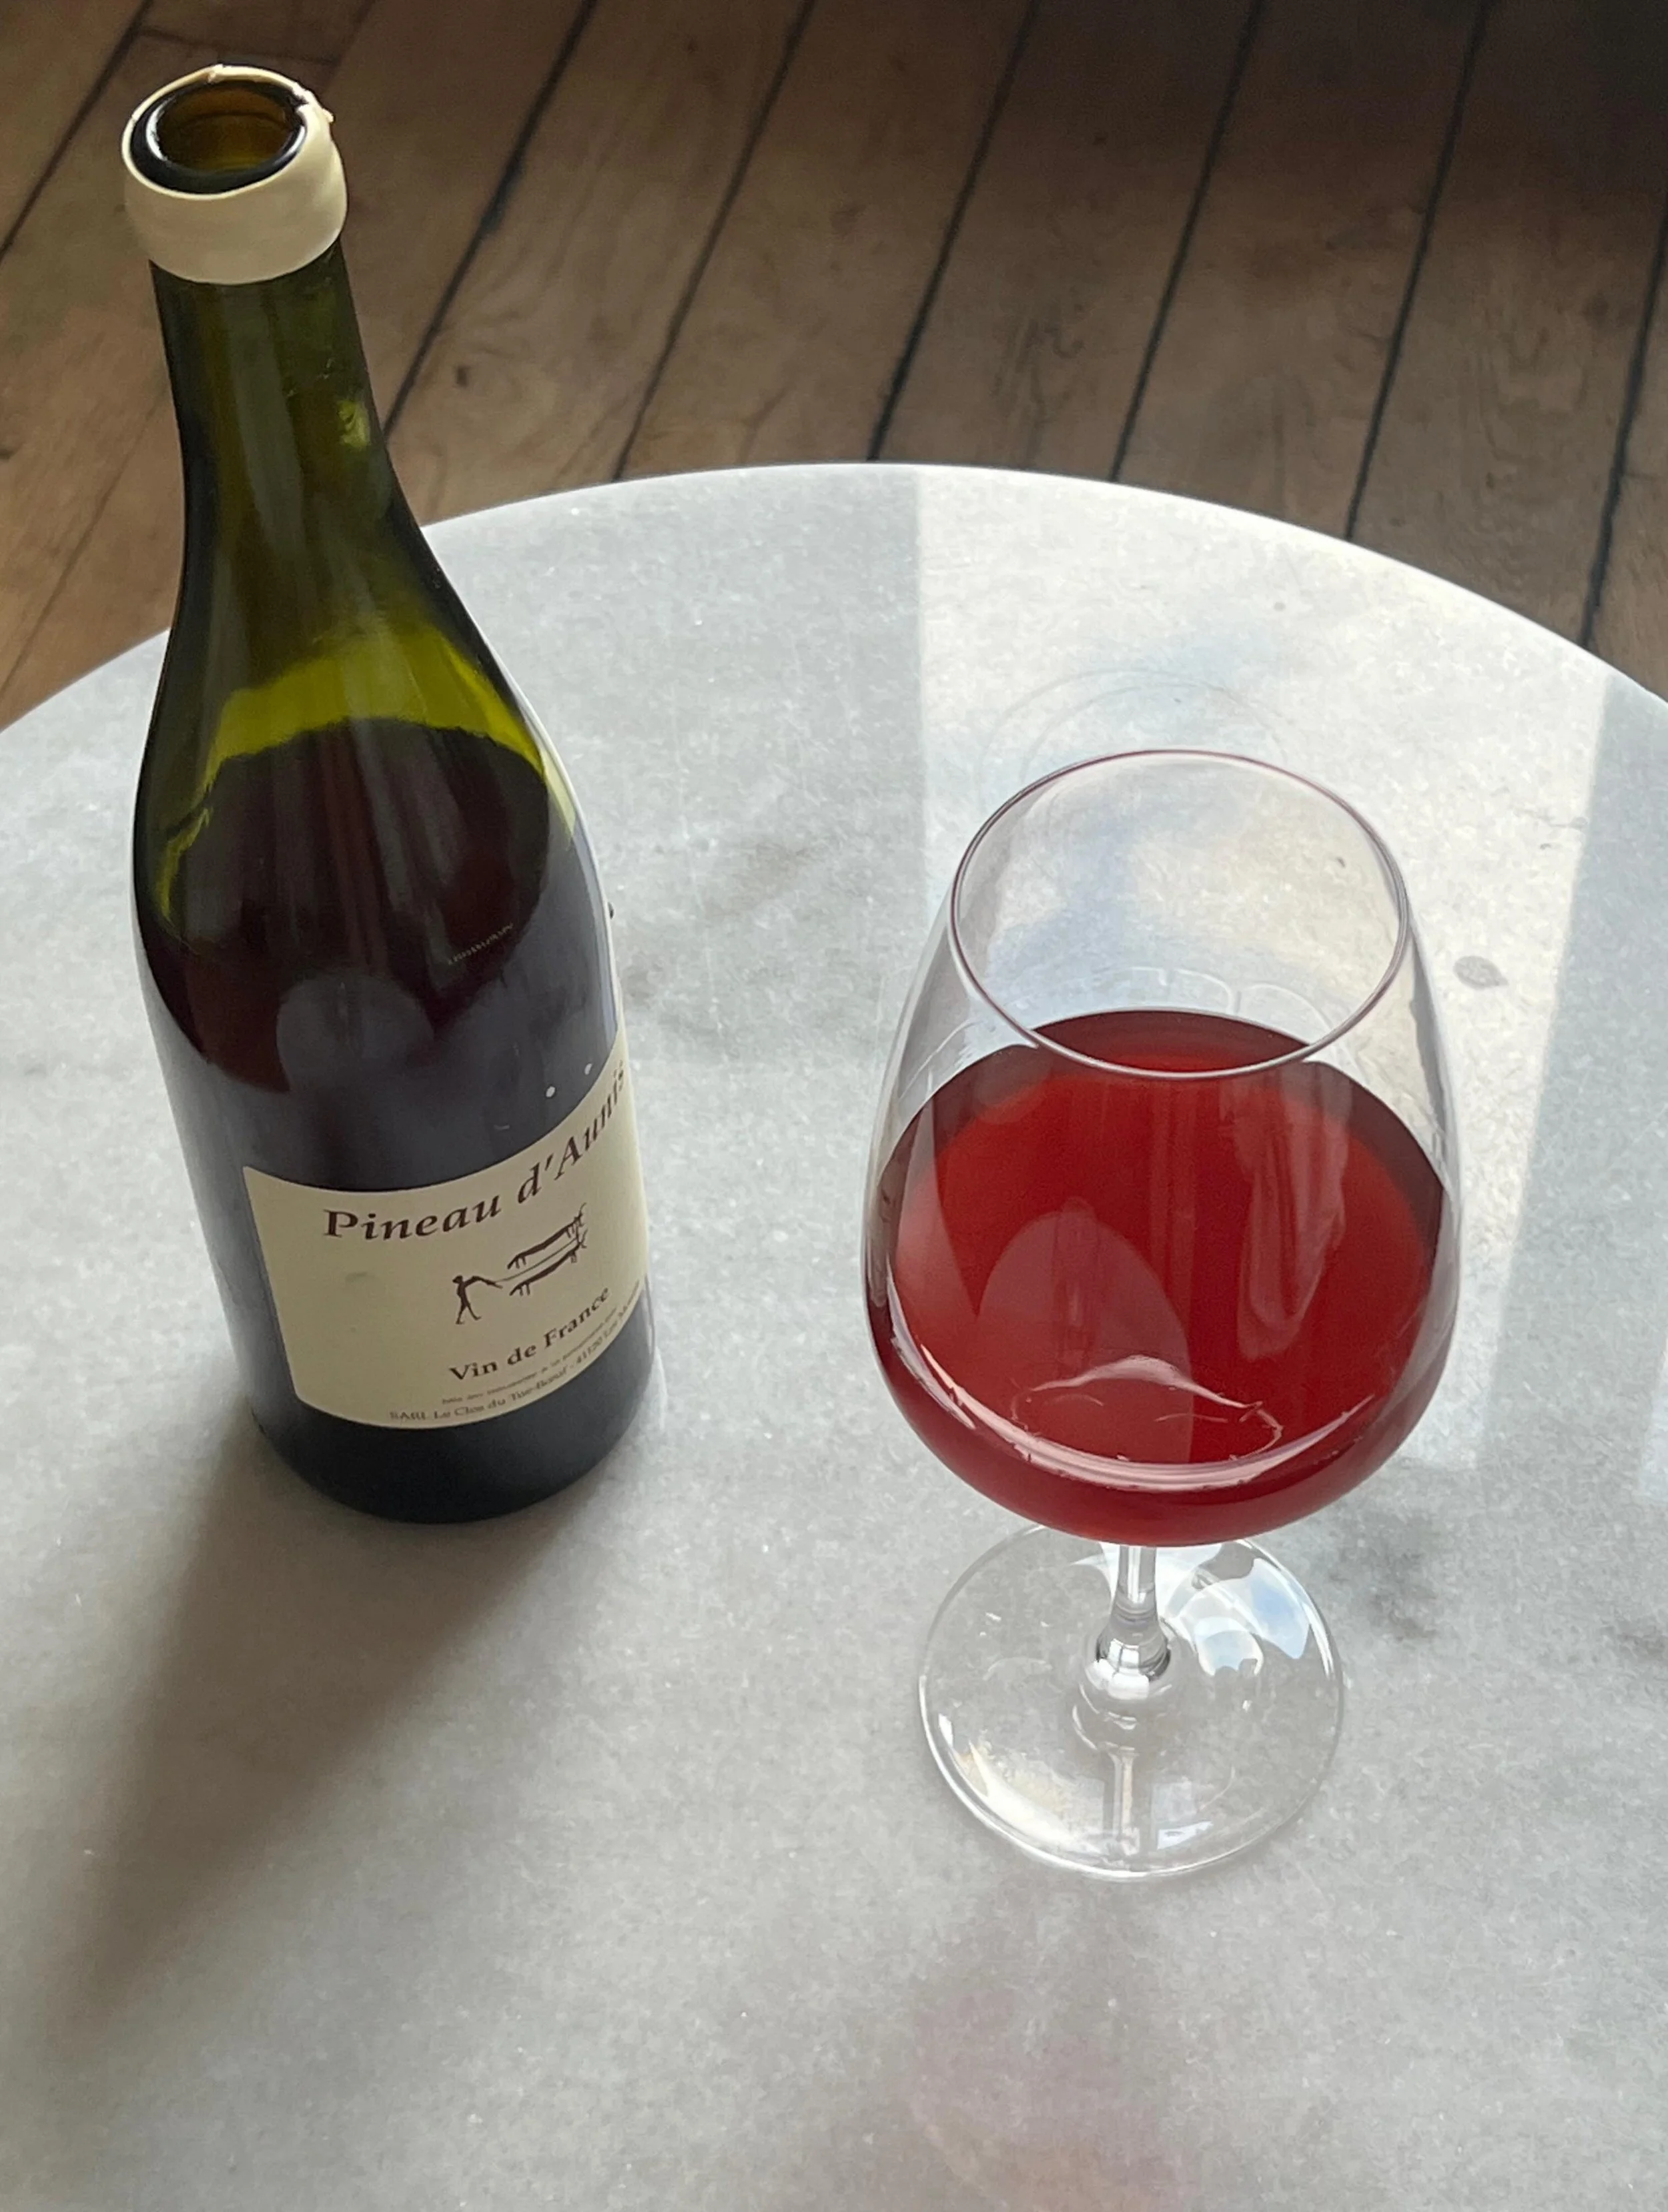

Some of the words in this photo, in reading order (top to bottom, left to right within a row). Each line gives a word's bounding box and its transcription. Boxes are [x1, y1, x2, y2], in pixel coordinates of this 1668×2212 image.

[324, 1195, 502, 1241] Pineau
[517, 1059, 625, 1205] d'Aunis
[448, 1362, 498, 1380] Vin
[507, 1345, 538, 1366] de
[543, 1287, 608, 1350] France
[454, 1405, 484, 1416] Clos
[488, 1399, 506, 1410] du
